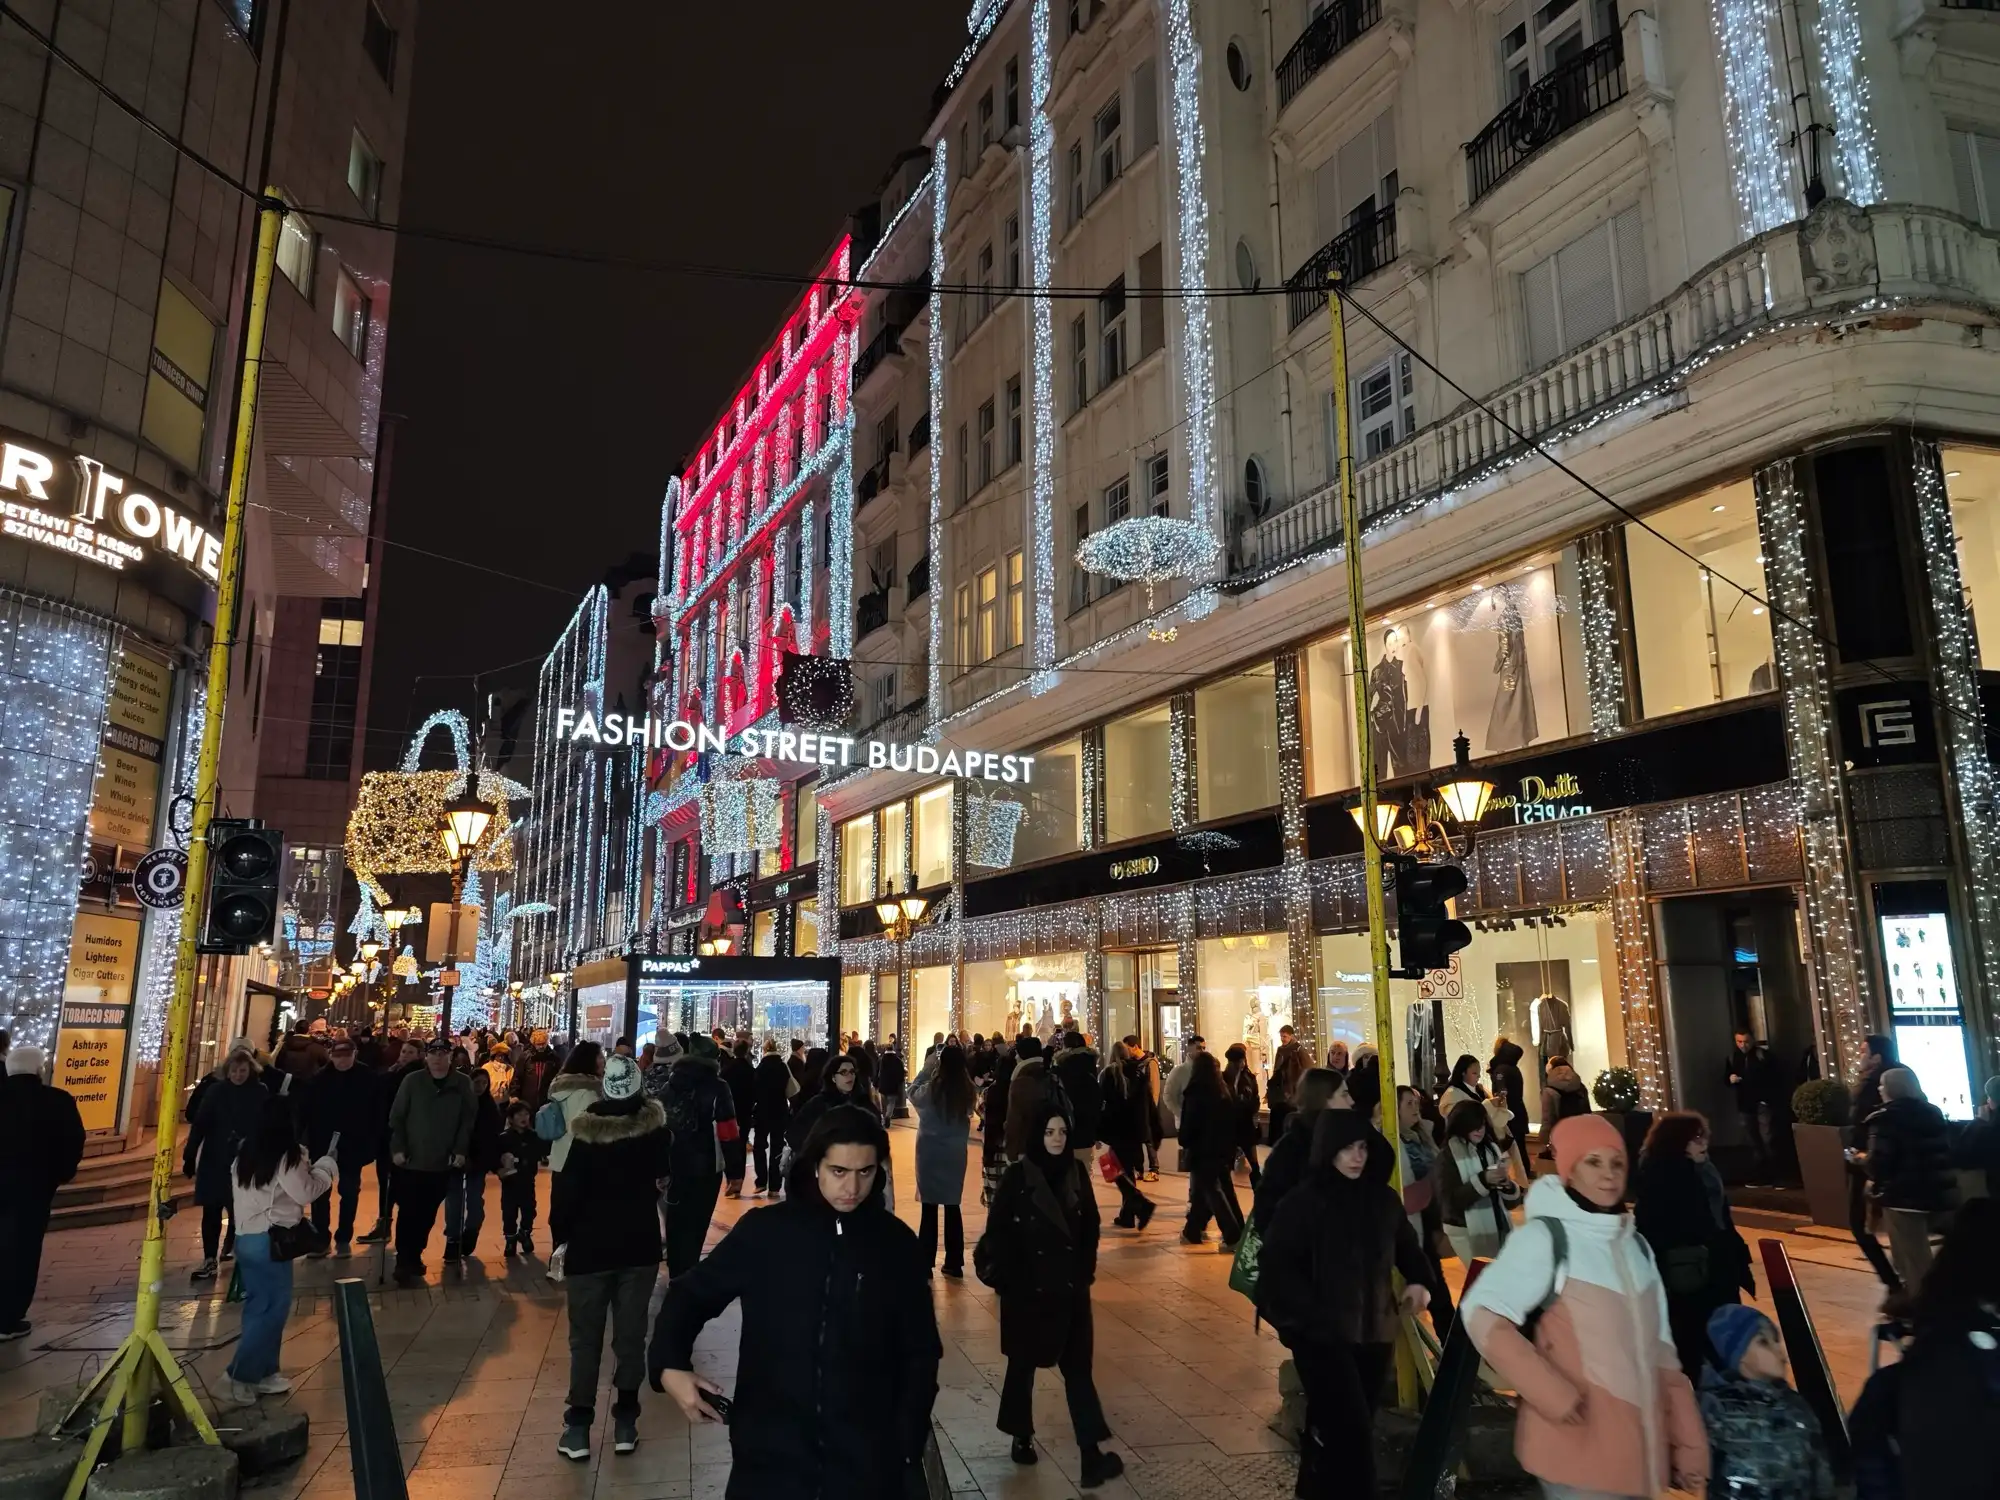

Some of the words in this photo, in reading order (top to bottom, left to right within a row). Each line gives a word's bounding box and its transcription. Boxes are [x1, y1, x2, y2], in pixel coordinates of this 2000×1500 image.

[152, 352, 186, 390] TOBACCO
[185, 381, 204, 405] SHOP
[70, 454, 222, 583] TOWE
[120, 657, 135, 673] Soft
[136, 665, 158, 682] drinks
[140, 682, 161, 698] drinks
[121, 707, 145, 724] Juices
[138, 737, 160, 758] SHOP
[555, 707, 726, 754] FASHION
[740, 728, 855, 767] STREET
[868, 741, 1035, 784] BUDAPEST
[116, 758, 138, 774] Beers
[114, 773, 136, 789] Wines
[1518, 772, 1583, 805] Dutti
[110, 789, 137, 807] Whisky
[128, 811, 150, 825] drinks
[107, 821, 132, 836] Coffee
[145, 850, 189, 865] NEMZETI
[85, 933, 123, 947] Humidors
[85, 951, 118, 964] Lighters
[73, 967, 95, 981] Cigar
[96, 969, 126, 981] Cutters
[642, 959, 691, 973] PAPPAS
[64, 1007, 103, 1024] TOBACCO
[103, 1008, 125, 1025] SHOP
[72, 1039, 108, 1052] Ashtrays
[66, 1057, 88, 1070] Cigar
[89, 1056, 110, 1067] Case
[64, 1074, 107, 1086] Humidifier
